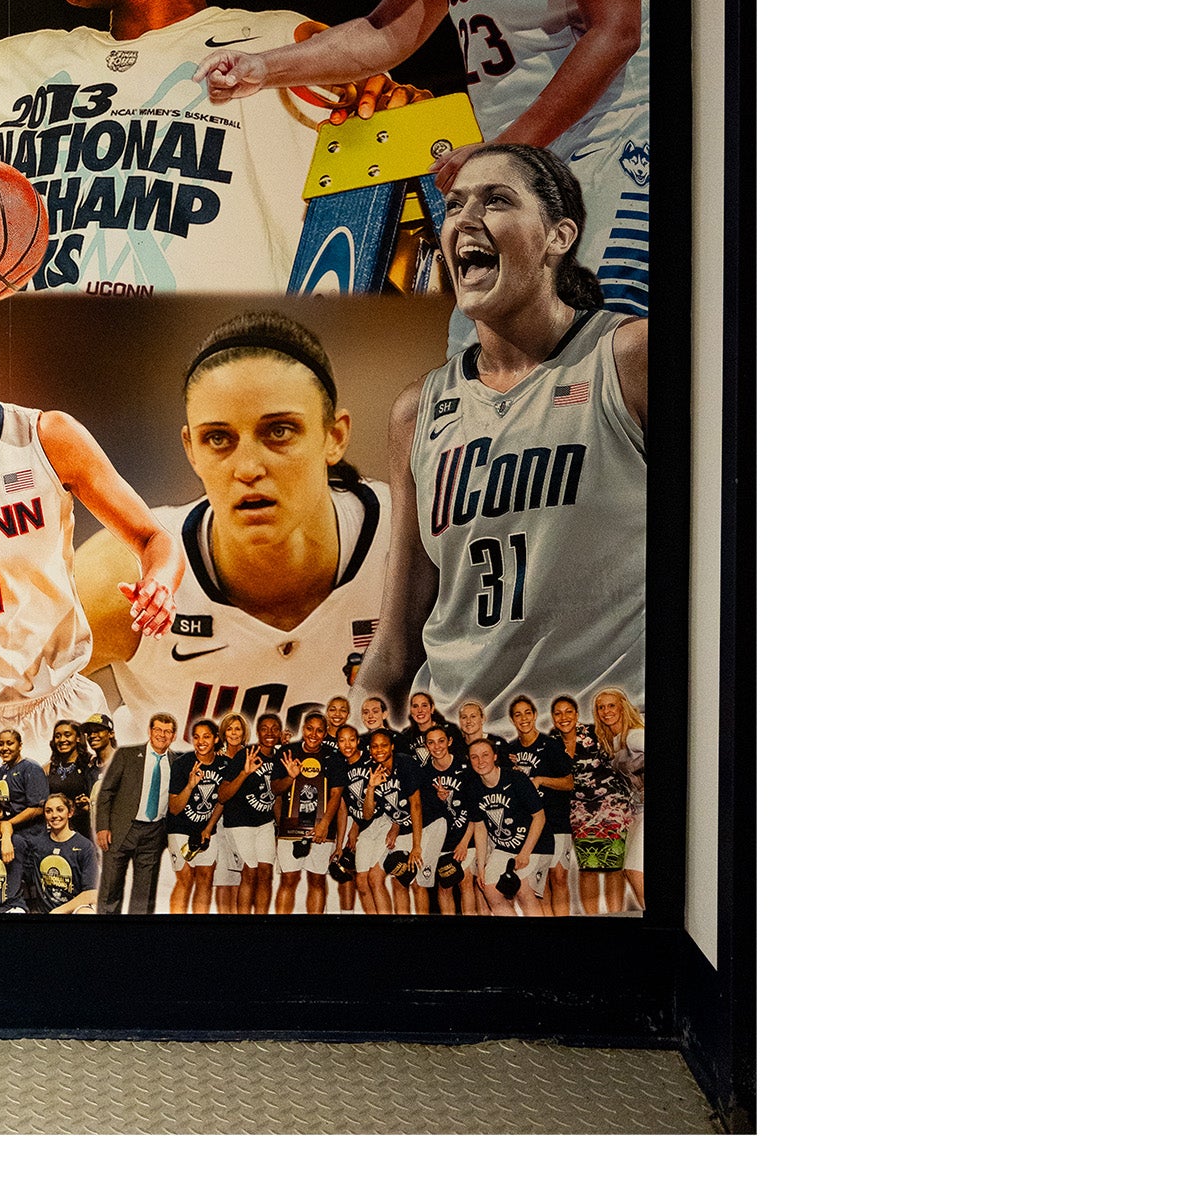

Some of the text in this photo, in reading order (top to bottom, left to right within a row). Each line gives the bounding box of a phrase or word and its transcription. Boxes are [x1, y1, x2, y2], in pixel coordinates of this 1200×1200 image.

[459, 14, 516, 85] 23
[0, 82, 118, 129] 2013
[86, 281, 154, 298] UCONN
[438, 401, 452, 412] SH
[431, 437, 587, 537] UConn
[469, 531, 528, 629] 31
[179, 620, 201, 633] SH
